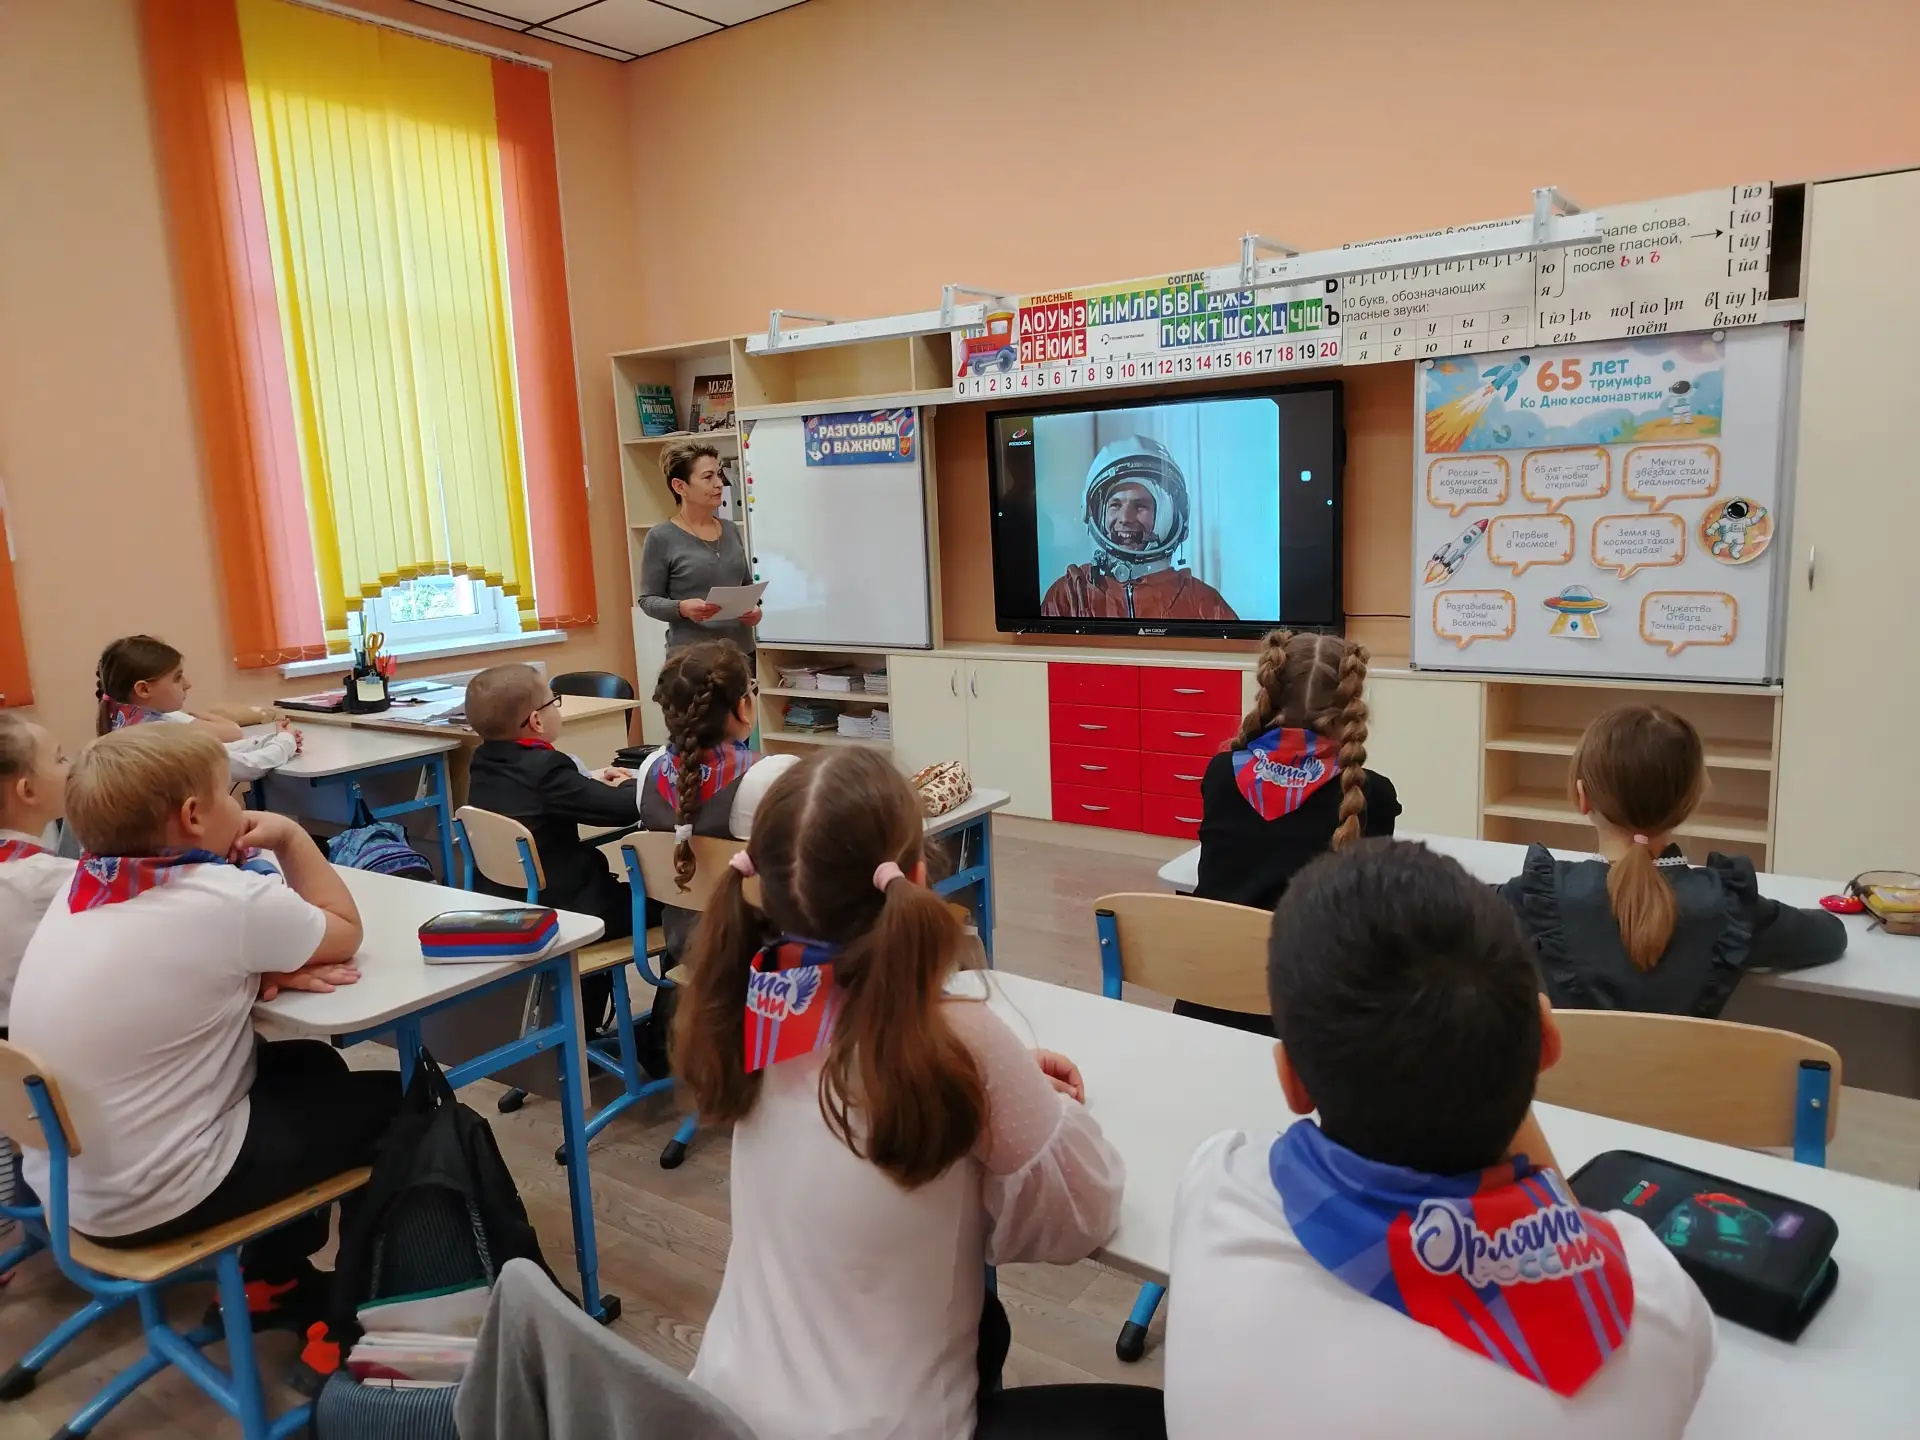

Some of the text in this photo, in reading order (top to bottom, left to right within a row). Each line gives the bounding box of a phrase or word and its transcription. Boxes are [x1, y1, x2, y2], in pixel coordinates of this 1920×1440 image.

[1642, 216, 1690, 232] слова,
[1573, 232, 1682, 258] после гласной,
[1573, 258, 1614, 274] после
[1636, 255, 1644, 265] и
[1168, 272, 1205, 286] СОГЛАС
[1031, 292, 1073, 305] ГЛАСНЫЕ
[1342, 282, 1486, 309] 10 букв, обозначающих
[1325, 305, 1340, 326] Ъ
[1342, 303, 1429, 323] гласные звуки:
[1553, 312, 1757, 343] ель поёт вьюн
[959, 341, 1338, 394] 0 1 2 3 4 5 6 7 8 9 10 11 12 13 14 15 16 17 18 19 20
[1537, 358, 1629, 393] 65 лет
[1589, 375, 1651, 391] триумфа
[1520, 390, 1663, 409] Ко Дню космонавтики
[819, 420, 897, 438] РАЗГОВОРЫ
[821, 437, 896, 454] О ВАЖНОМ!
[1651, 458, 1685, 466] Мечты
[1448, 469, 1478, 477] Россия
[1534, 463, 1599, 474] 65 лет старт
[1635, 467, 1677, 479] звёздах
[1544, 472, 1589, 481] для новых
[1440, 478, 1498, 487] космическая
[1545, 480, 1588, 490] открытий!
[1638, 479, 1706, 488] реальностью
[1449, 486, 1488, 495] держава
[1512, 530, 1549, 540] Первые
[1618, 528, 1660, 537] Земля из
[1506, 540, 1557, 548] в космосе!
[1603, 537, 1675, 546] космоса такая
[1615, 546, 1663, 555] красивая!
[1446, 602, 1503, 612] Разгадываем
[1666, 612, 1702, 621] Отвага
[1452, 618, 1497, 627] Вселенной
[1651, 621, 1722, 632] Точный расчёт
[1414, 1204, 1585, 1275] Орлята
